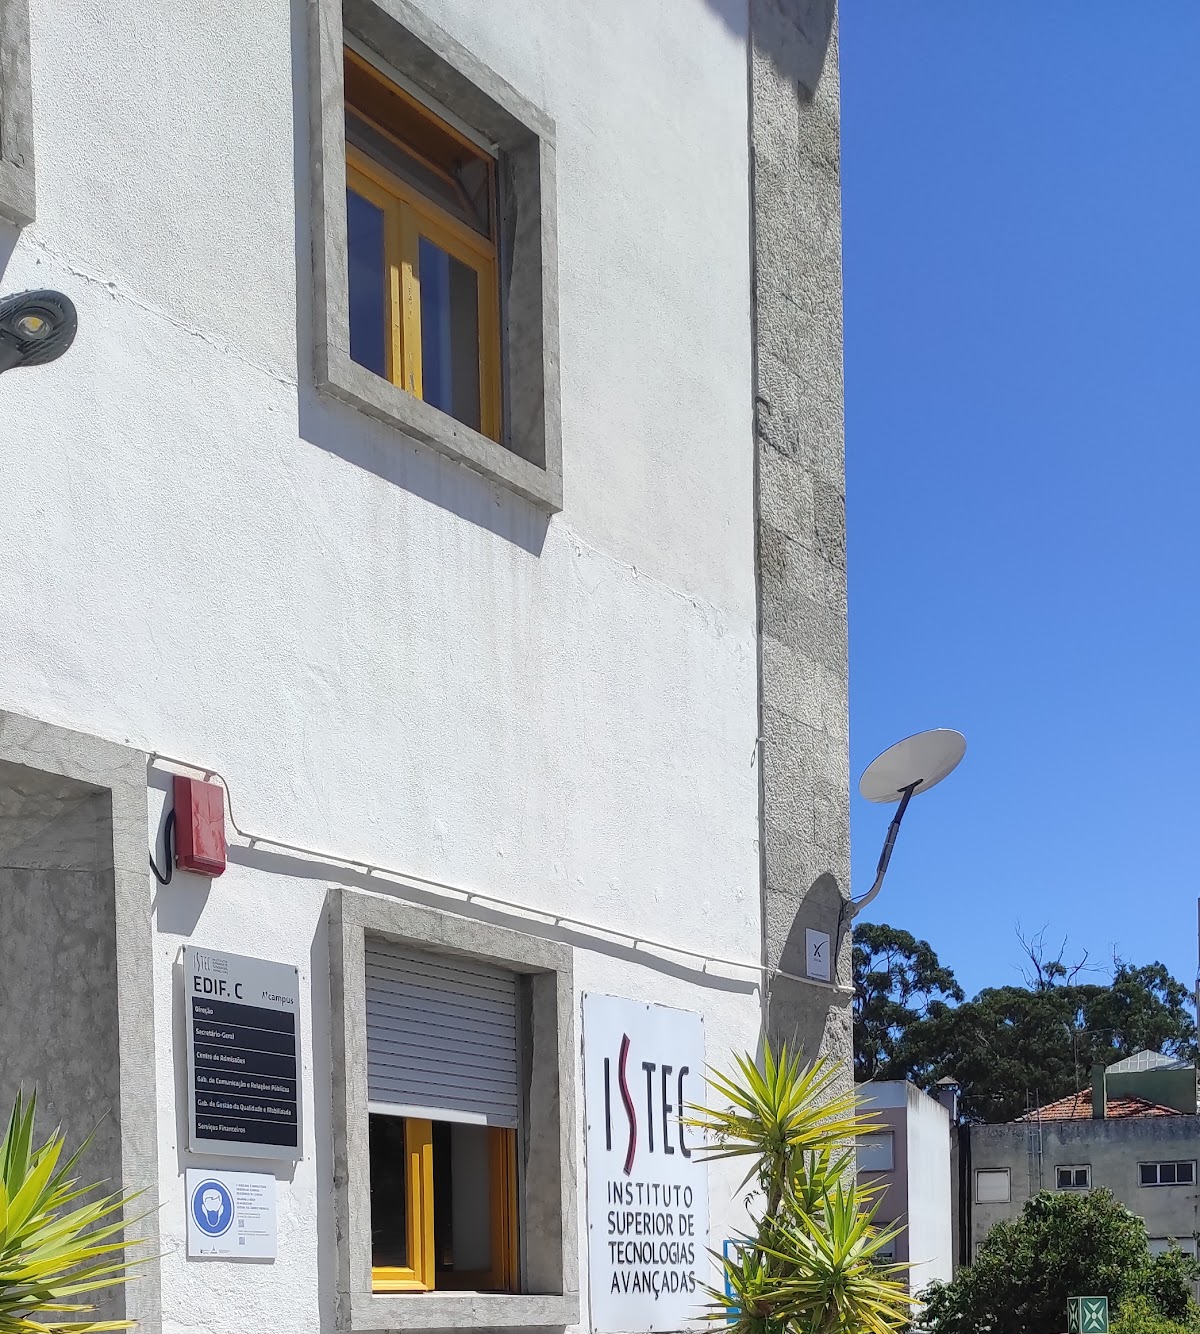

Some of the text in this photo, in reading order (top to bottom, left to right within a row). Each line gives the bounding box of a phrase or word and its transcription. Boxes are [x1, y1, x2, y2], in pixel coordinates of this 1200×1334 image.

[193, 952, 210, 972] ISTEC
[193, 975, 243, 999] EDIF. C
[194, 1005, 214, 1015] Direção
[195, 1028, 235, 1039] Secretário-Geral
[196, 1051, 212, 1060] Centro
[220, 1054, 246, 1064] Admissões
[215, 1077, 246, 1089] Comunicação
[250, 1081, 271, 1091] Relações
[271, 1084, 290, 1093] Públicas
[197, 1099, 209, 1107] Gab.
[209, 1099, 216, 1107] de
[216, 1100, 233, 1109] Gestão
[240, 1104, 263, 1113] Qualidade
[604, 1032, 691, 1176] ISTEC
[197, 1122, 246, 1134] Serviços Financeiros
[607, 1180, 693, 1208] INSTITUTO
[607, 1211, 695, 1237] SUPERIOR DE
[608, 1241, 695, 1265] TECNOLOGIAS
[610, 1270, 696, 1299] AVANÇADAS
